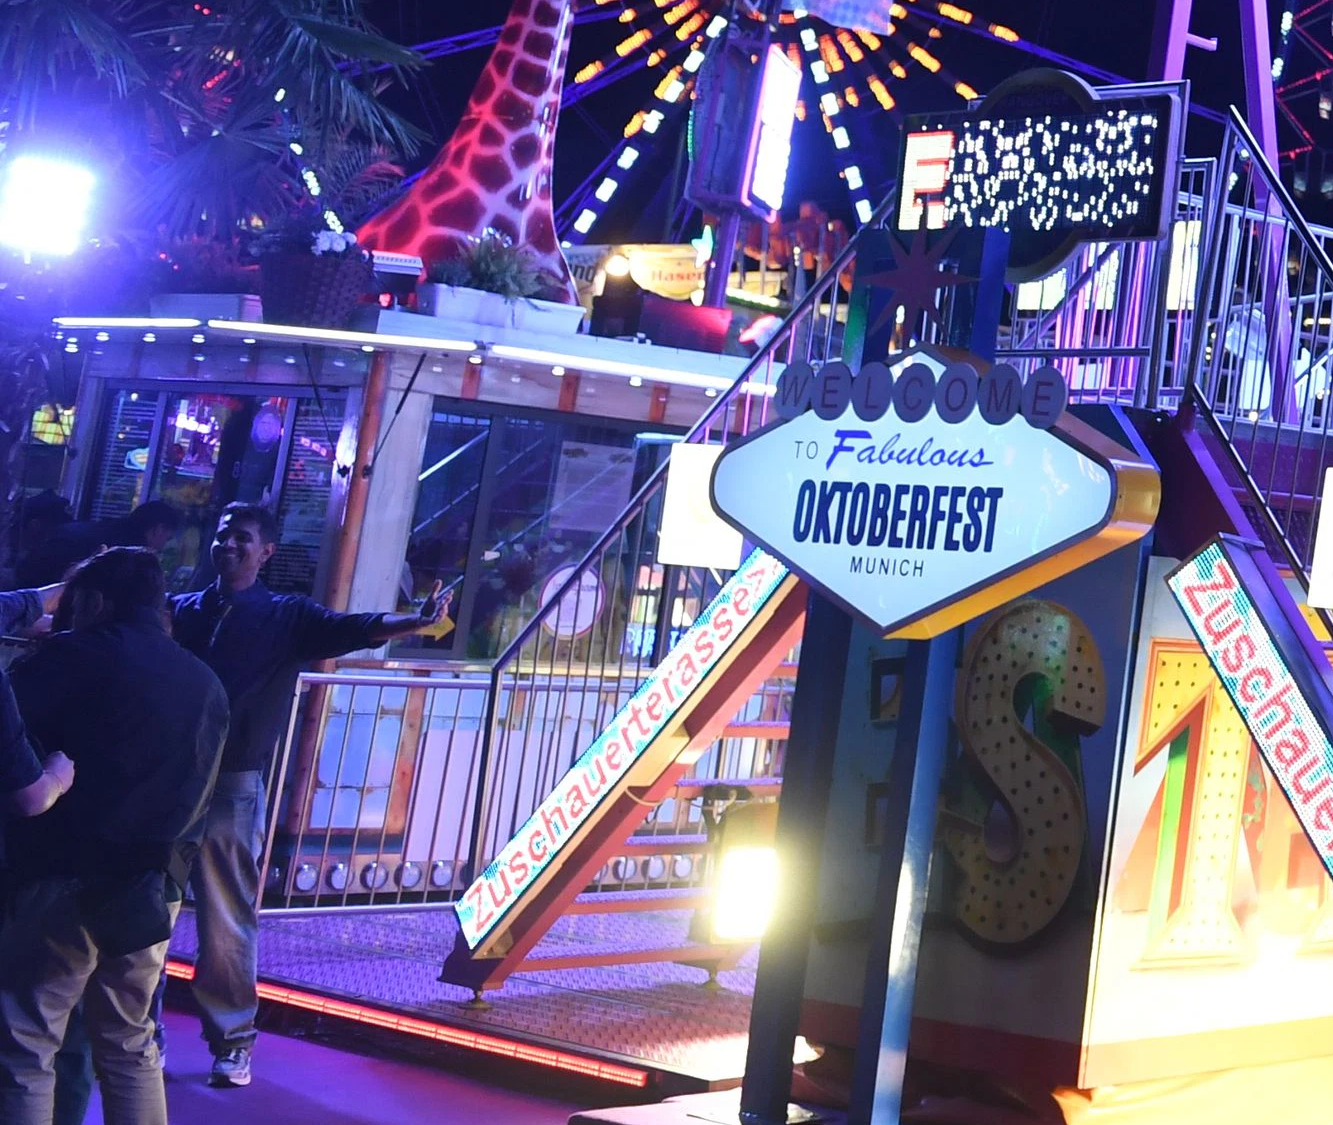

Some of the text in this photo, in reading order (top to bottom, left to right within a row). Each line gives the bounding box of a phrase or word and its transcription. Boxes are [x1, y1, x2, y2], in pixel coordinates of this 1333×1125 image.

[780, 374, 1056, 419] WELCOME
[794, 428, 994, 470] TO Fabulous
[793, 479, 1004, 553] OKTOBERFEST
[849, 555, 925, 579] MUNICH
